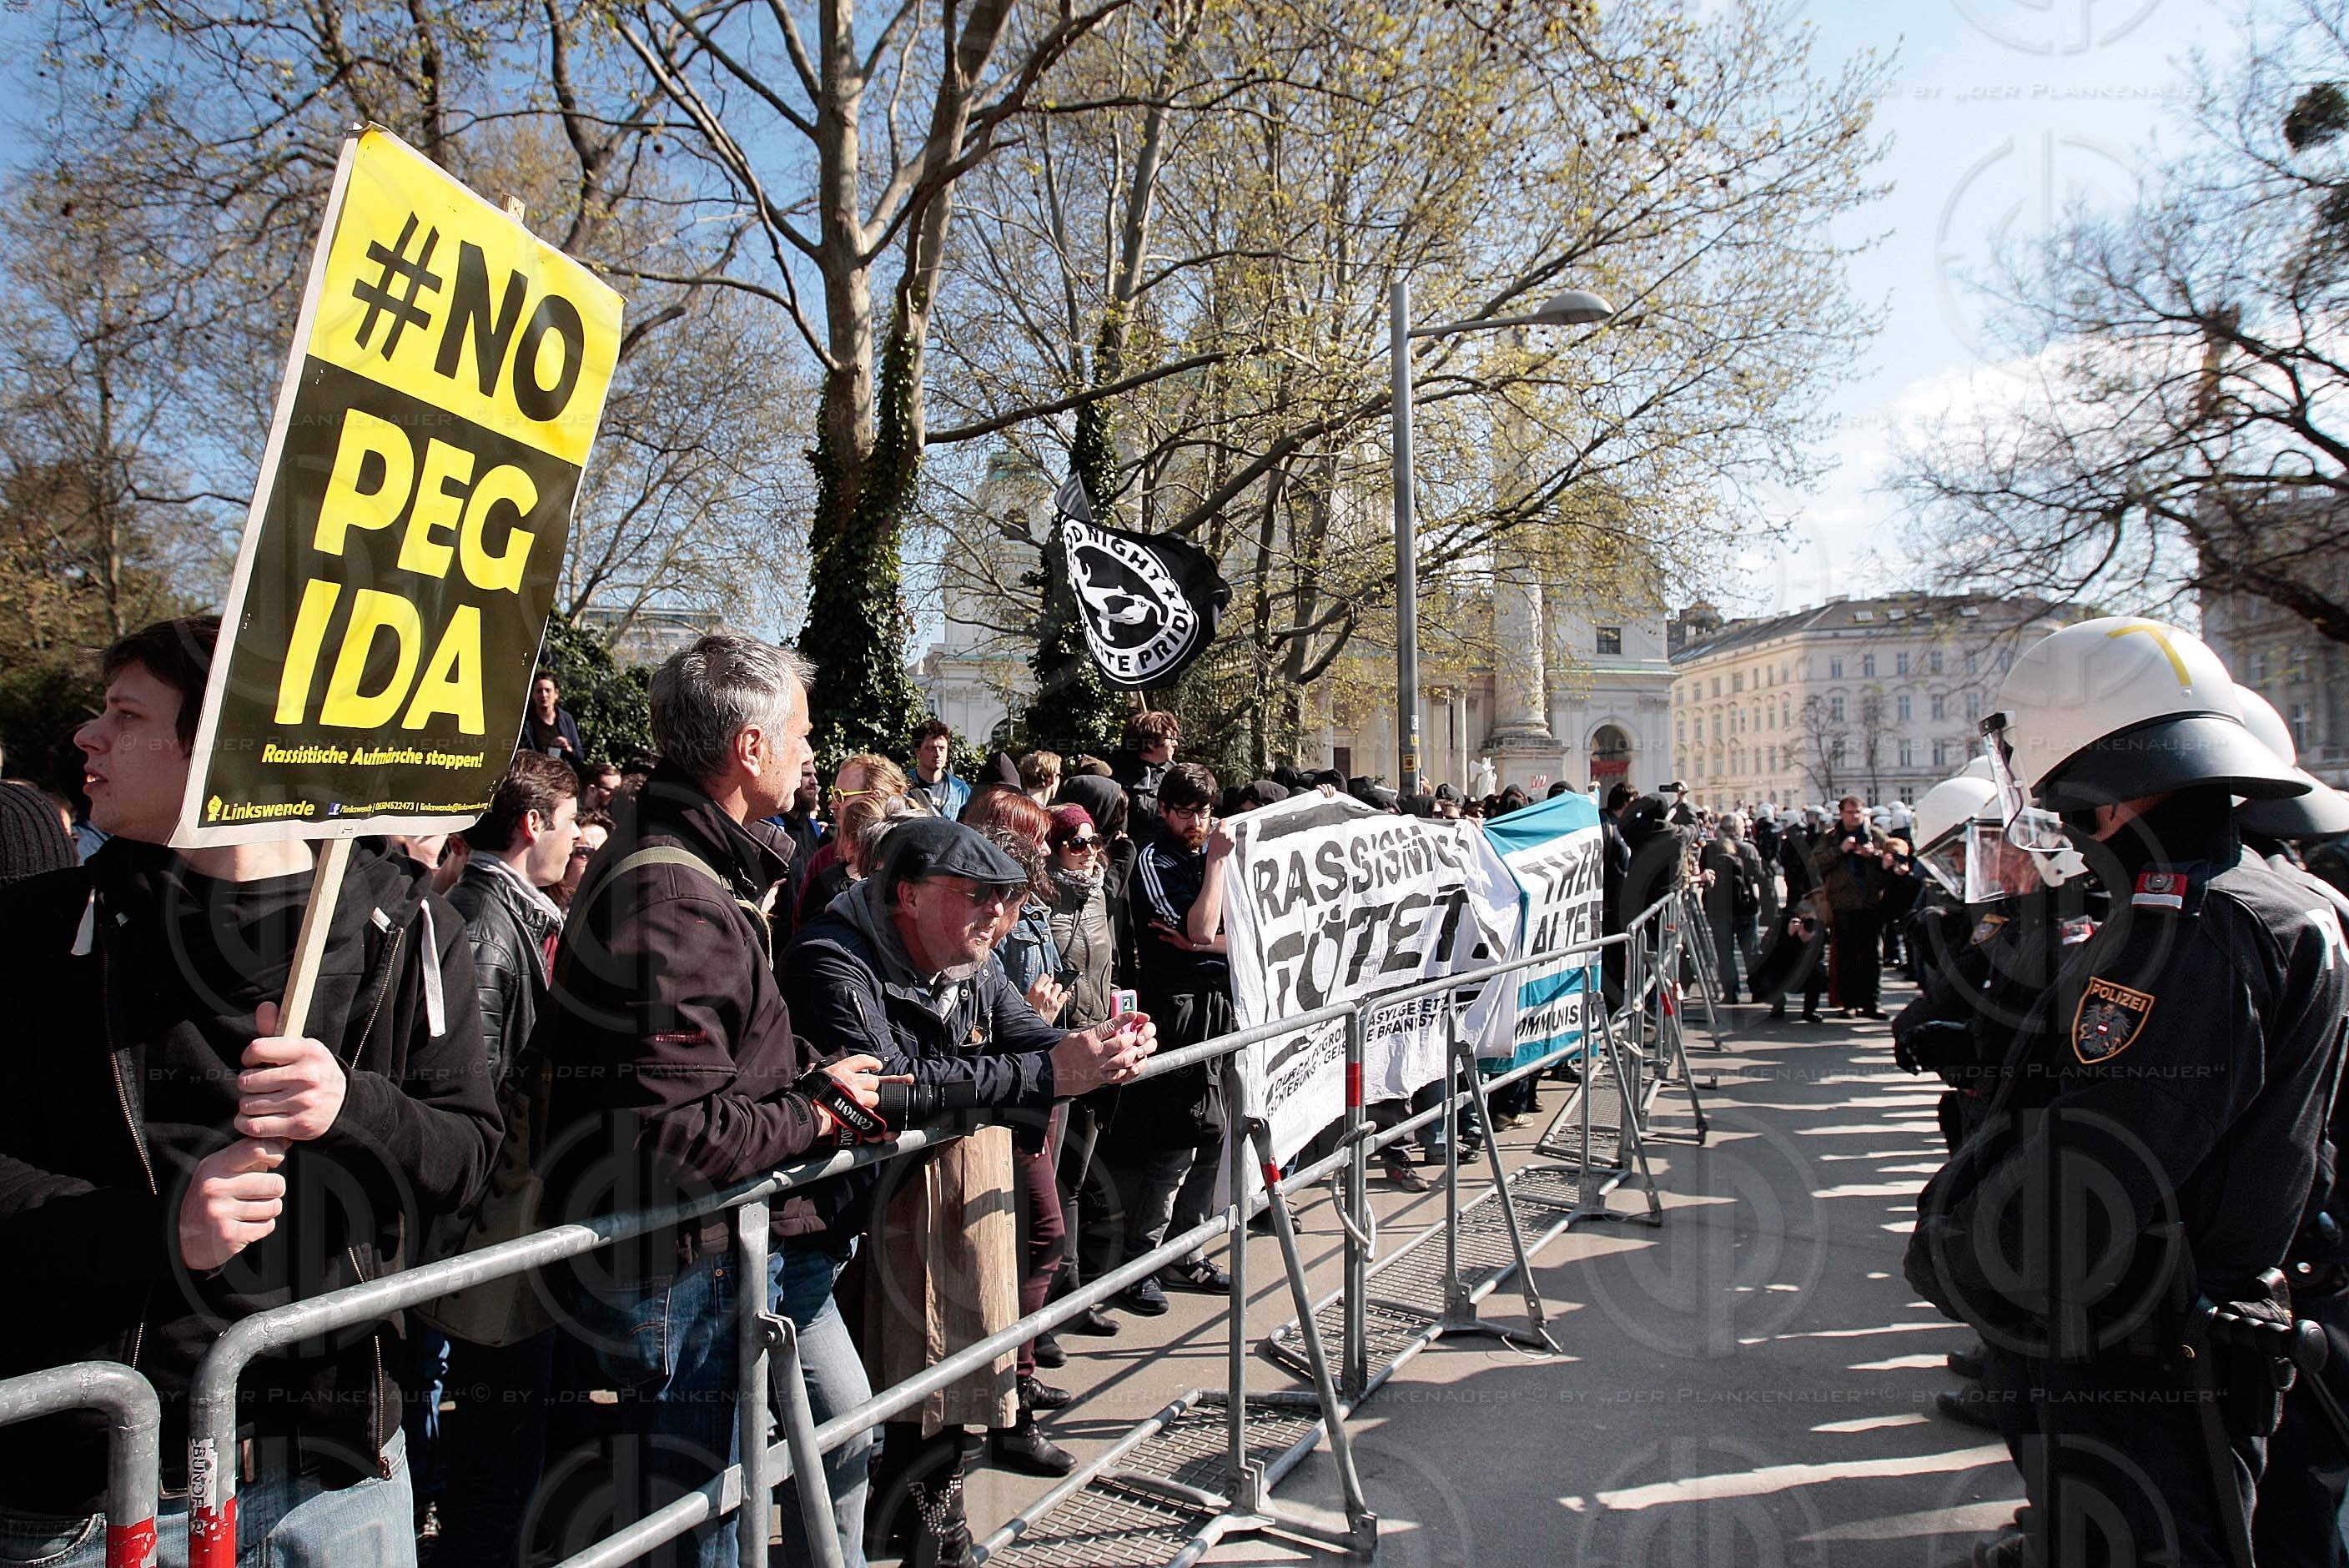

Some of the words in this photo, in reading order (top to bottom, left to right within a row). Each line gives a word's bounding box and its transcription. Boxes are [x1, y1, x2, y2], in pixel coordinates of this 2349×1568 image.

[351, 211, 586, 423] #NO
[313, 406, 541, 595] PEG
[1087, 528, 1165, 581] NIGHT
[273, 578, 485, 736] IDA
[1137, 606, 1189, 671] PRID
[261, 743, 348, 765] Rassistische
[350, 746, 424, 766] Aufmärsche
[425, 750, 485, 770] stoppen!
[220, 800, 315, 822] Linkswende
[2090, 983, 2147, 1013] POLIZEI
[834, 1098, 873, 1130] Canon
